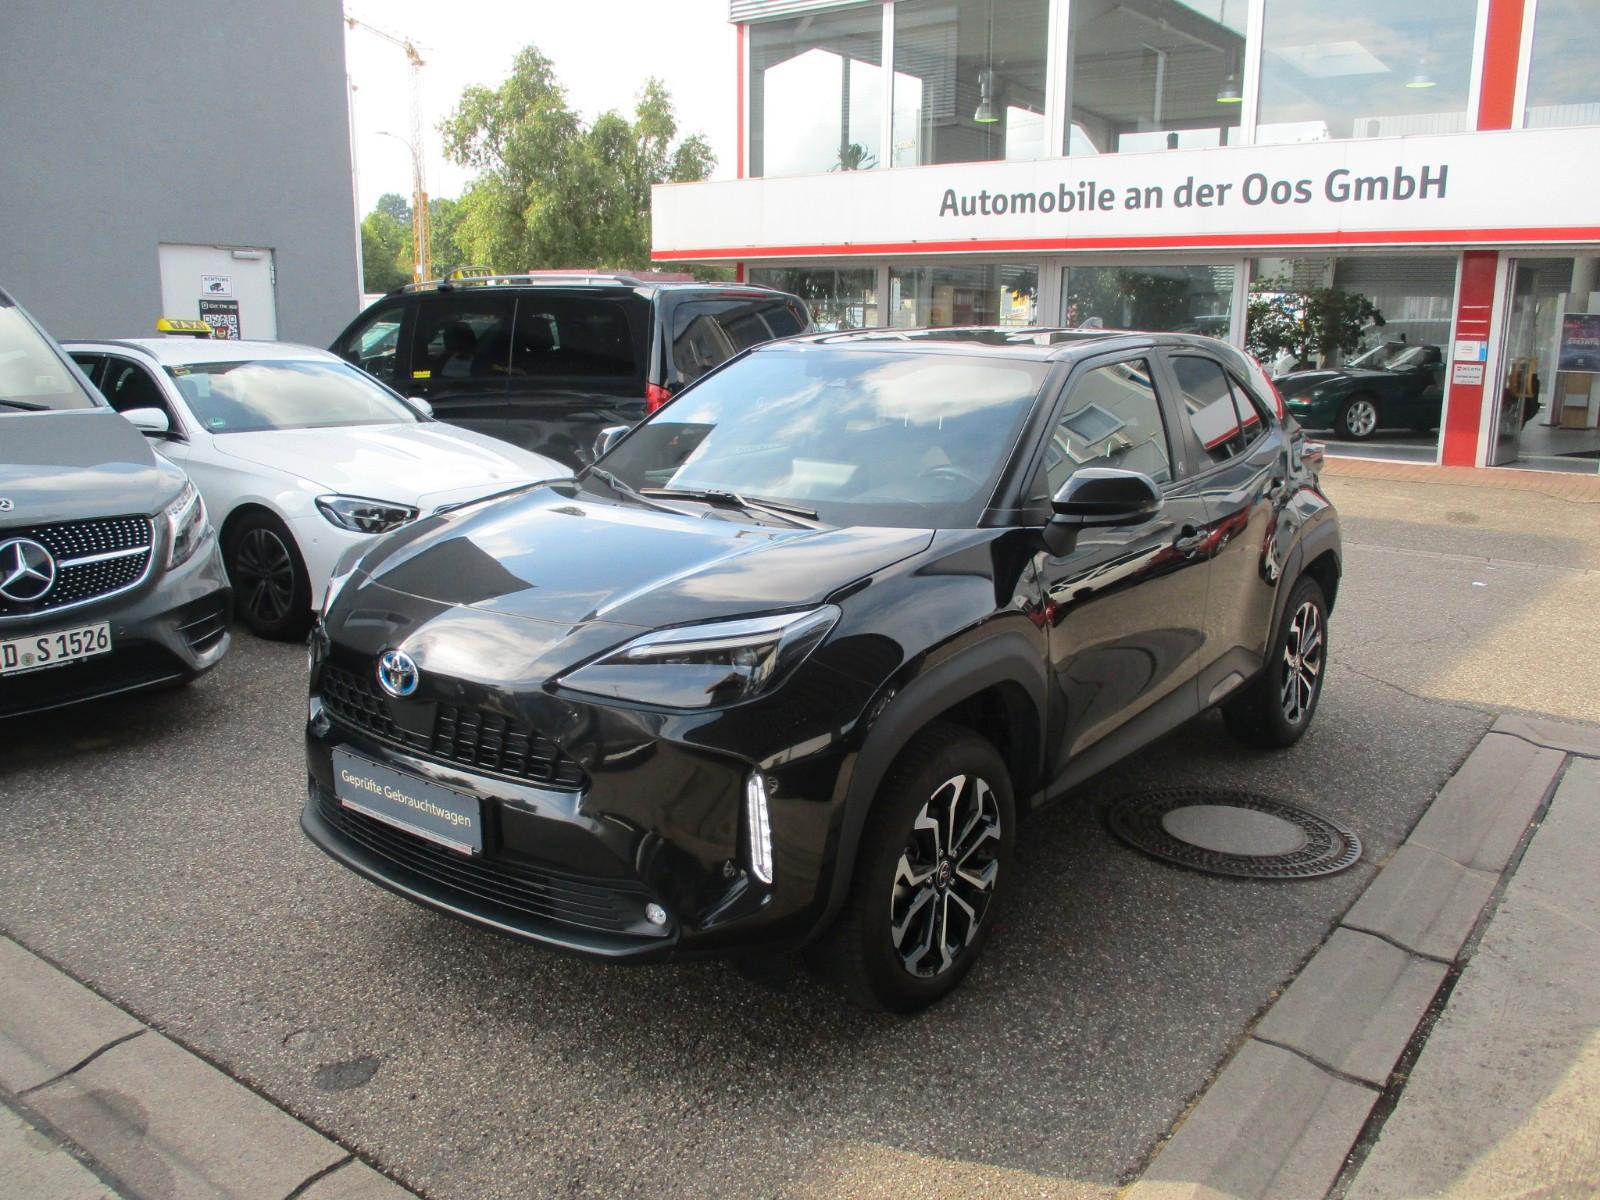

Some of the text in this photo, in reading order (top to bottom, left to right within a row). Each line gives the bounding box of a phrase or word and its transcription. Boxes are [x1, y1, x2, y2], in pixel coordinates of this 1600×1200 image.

[940, 164, 1448, 217] Automobile an der Oos GmbH
[37, 638, 51, 661] S
[56, 627, 107, 658] 1526
[341, 769, 472, 828] Geprüfte Gebrauchtwagen
